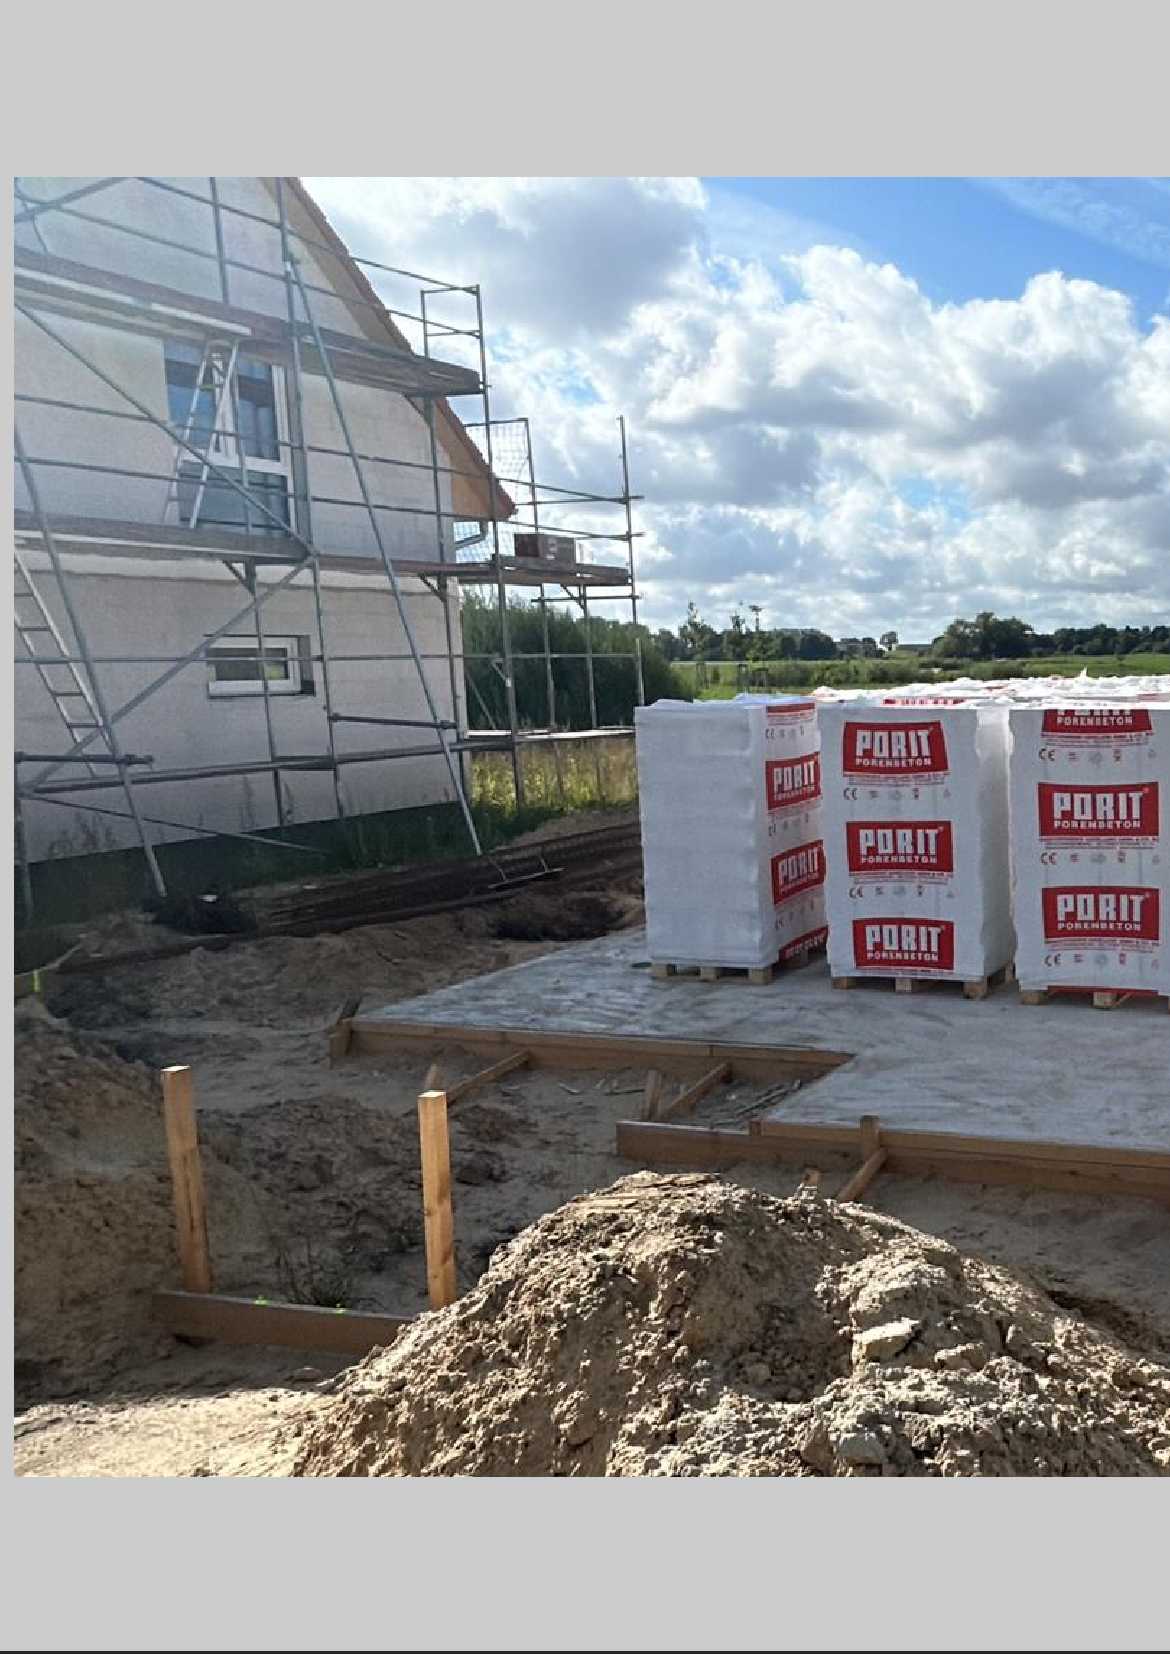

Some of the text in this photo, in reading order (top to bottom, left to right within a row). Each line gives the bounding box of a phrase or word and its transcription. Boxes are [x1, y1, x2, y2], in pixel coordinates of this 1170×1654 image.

[856, 729, 931, 757] PORIT
[1053, 792, 1143, 820] PORIT
[1054, 820, 1141, 830] PORENBETON
[859, 828, 939, 855] PORIT
[1057, 893, 1144, 922] PORIT
[865, 924, 941, 952] PORIT
